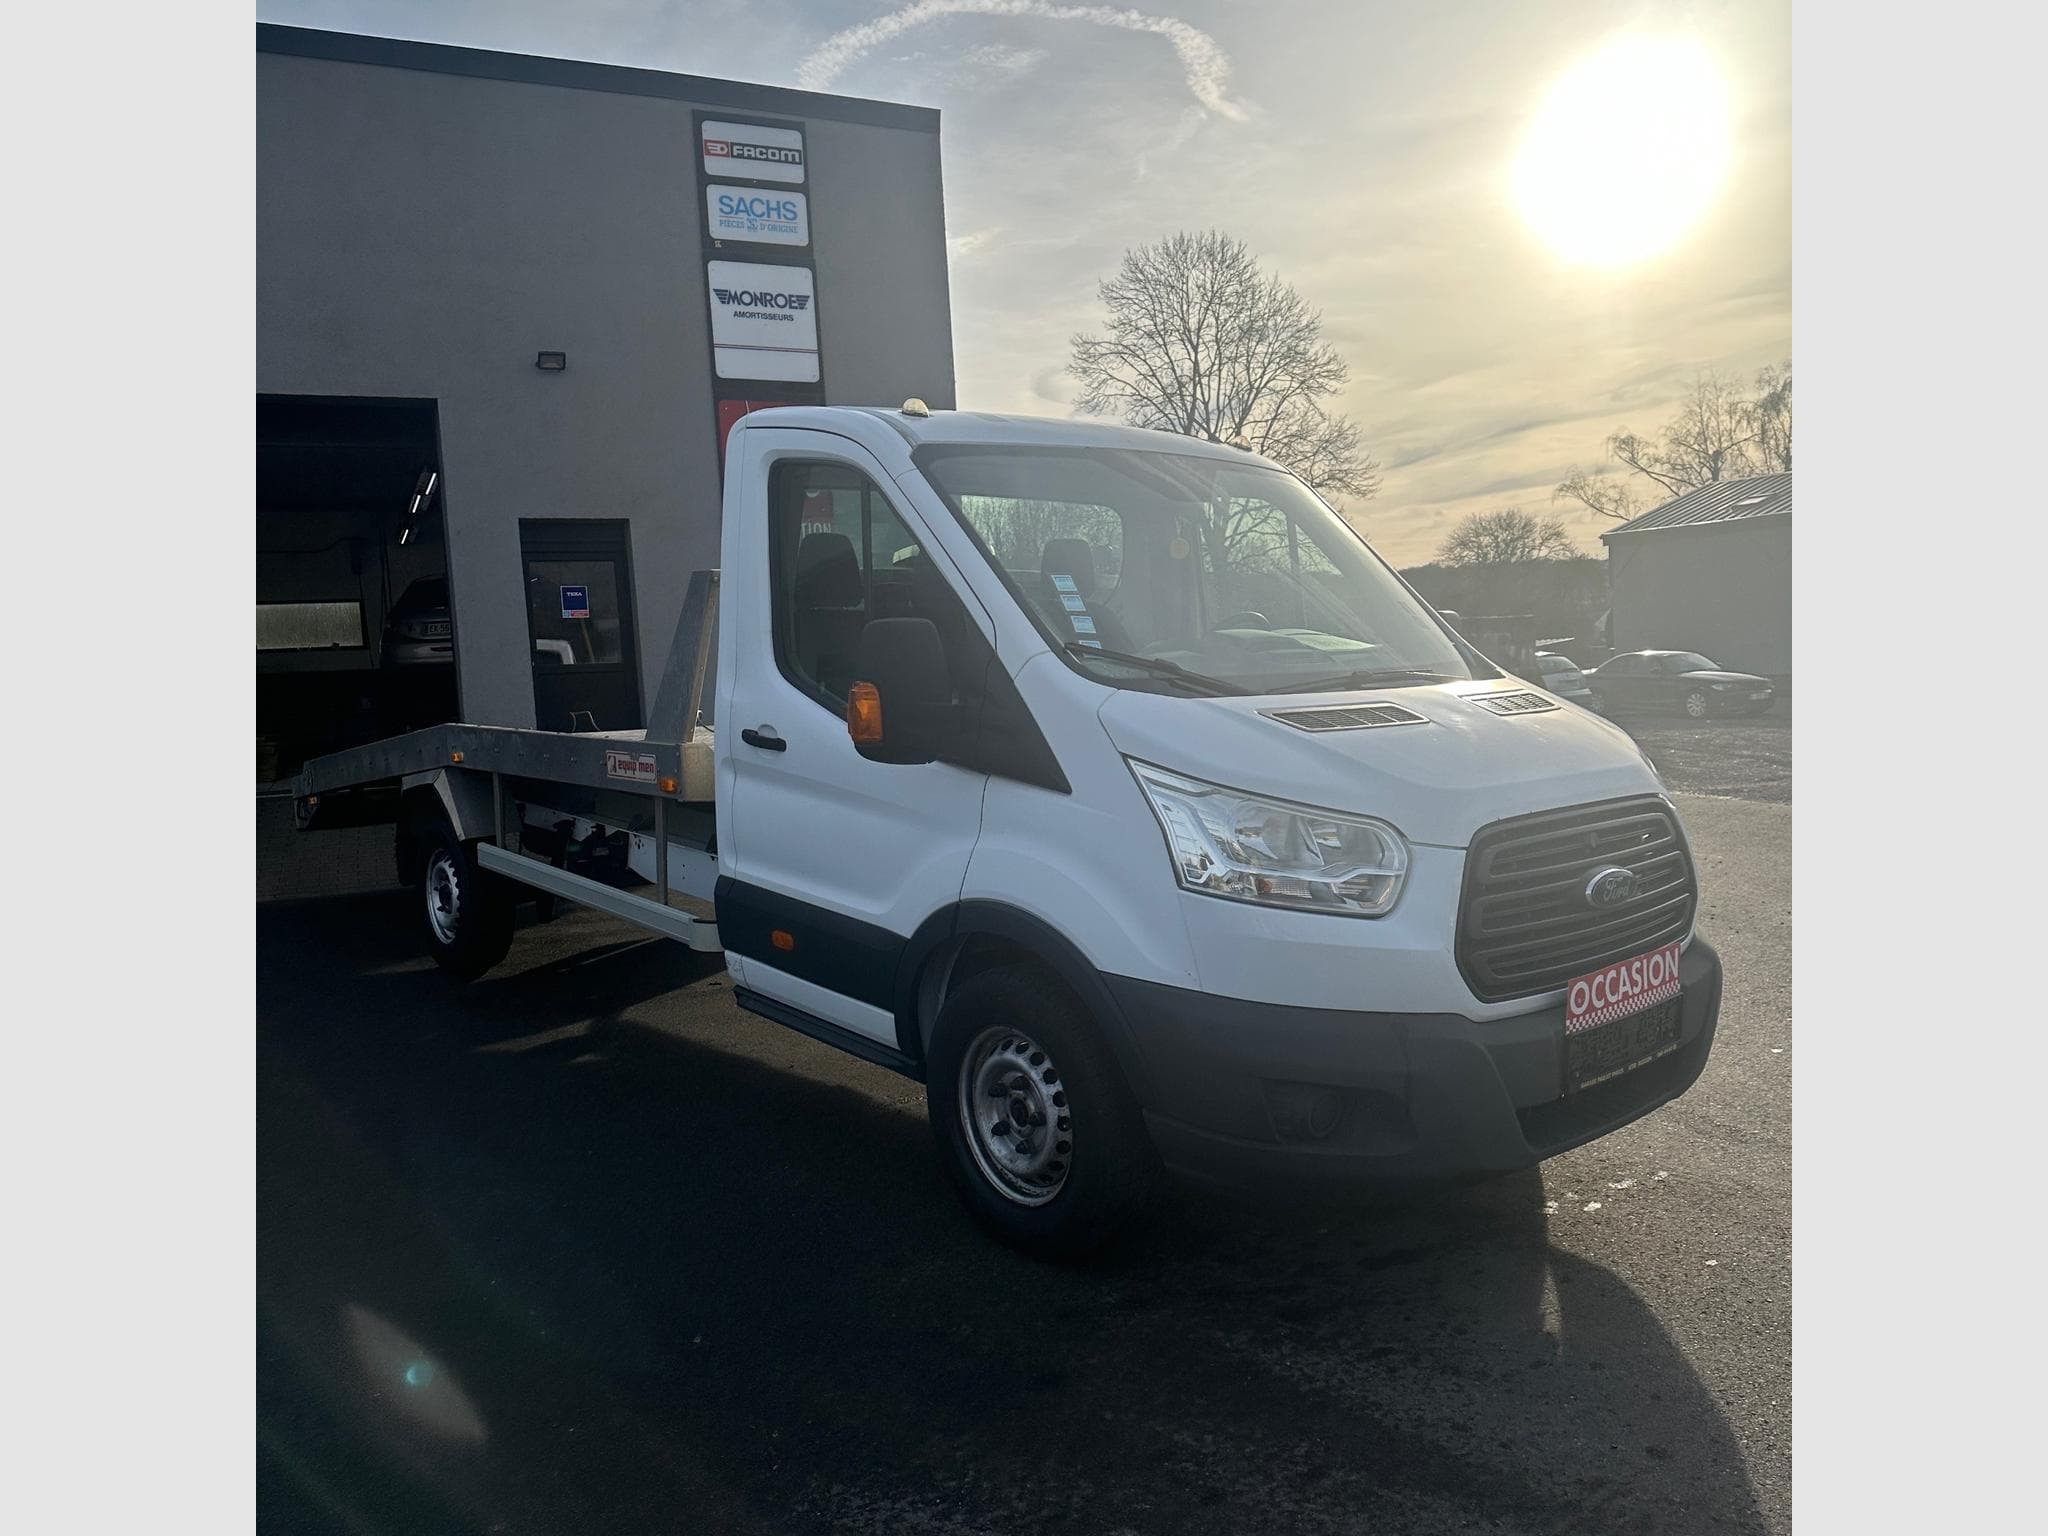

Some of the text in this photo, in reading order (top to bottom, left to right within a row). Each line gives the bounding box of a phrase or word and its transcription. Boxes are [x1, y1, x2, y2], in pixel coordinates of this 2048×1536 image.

[718, 195, 798, 221] SACHS
[726, 290, 798, 309] MONROE
[734, 311, 794, 322] AMORTISSEURS
[1603, 876, 1633, 902] Ford
[1570, 947, 1679, 1015] OCCASION
